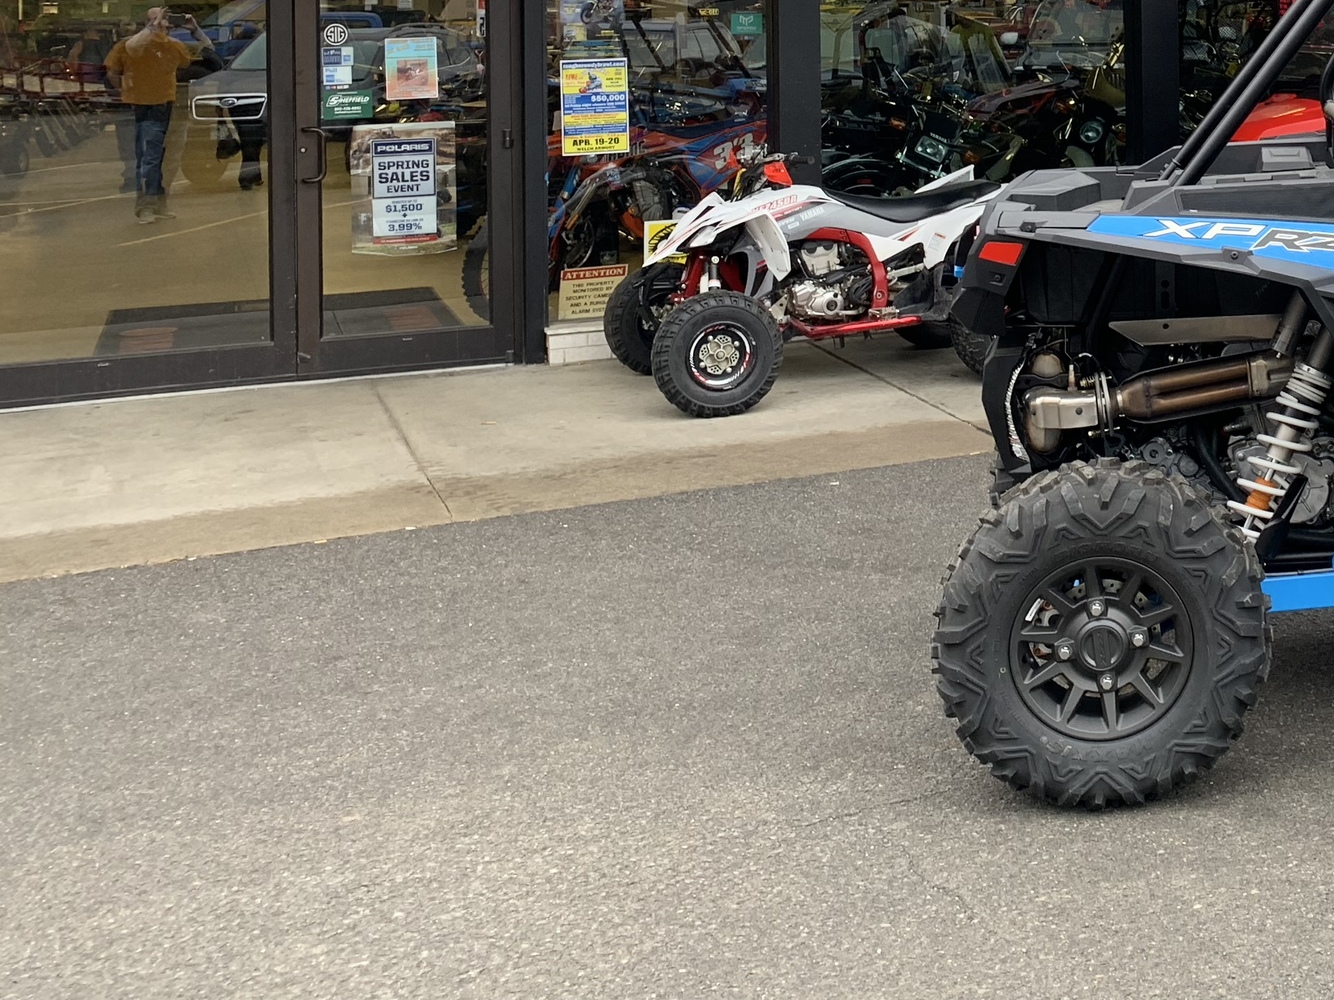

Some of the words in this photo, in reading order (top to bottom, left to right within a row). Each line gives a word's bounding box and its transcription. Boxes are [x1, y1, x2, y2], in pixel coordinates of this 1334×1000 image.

[591, 94, 625, 102] $50,000
[573, 139, 593, 147] APR.
[595, 137, 620, 145] 19-20
[377, 143, 430, 152] POLARIS
[378, 159, 430, 171] SPRING
[378, 170, 430, 184] SALES
[387, 184, 421, 193] EVENT
[385, 203, 423, 213] $1,500
[799, 206, 825, 221] YAMAHA
[388, 222, 423, 232] 3.99%
[1142, 219, 1267, 240] XP
[565, 268, 624, 279] ATTENTION
